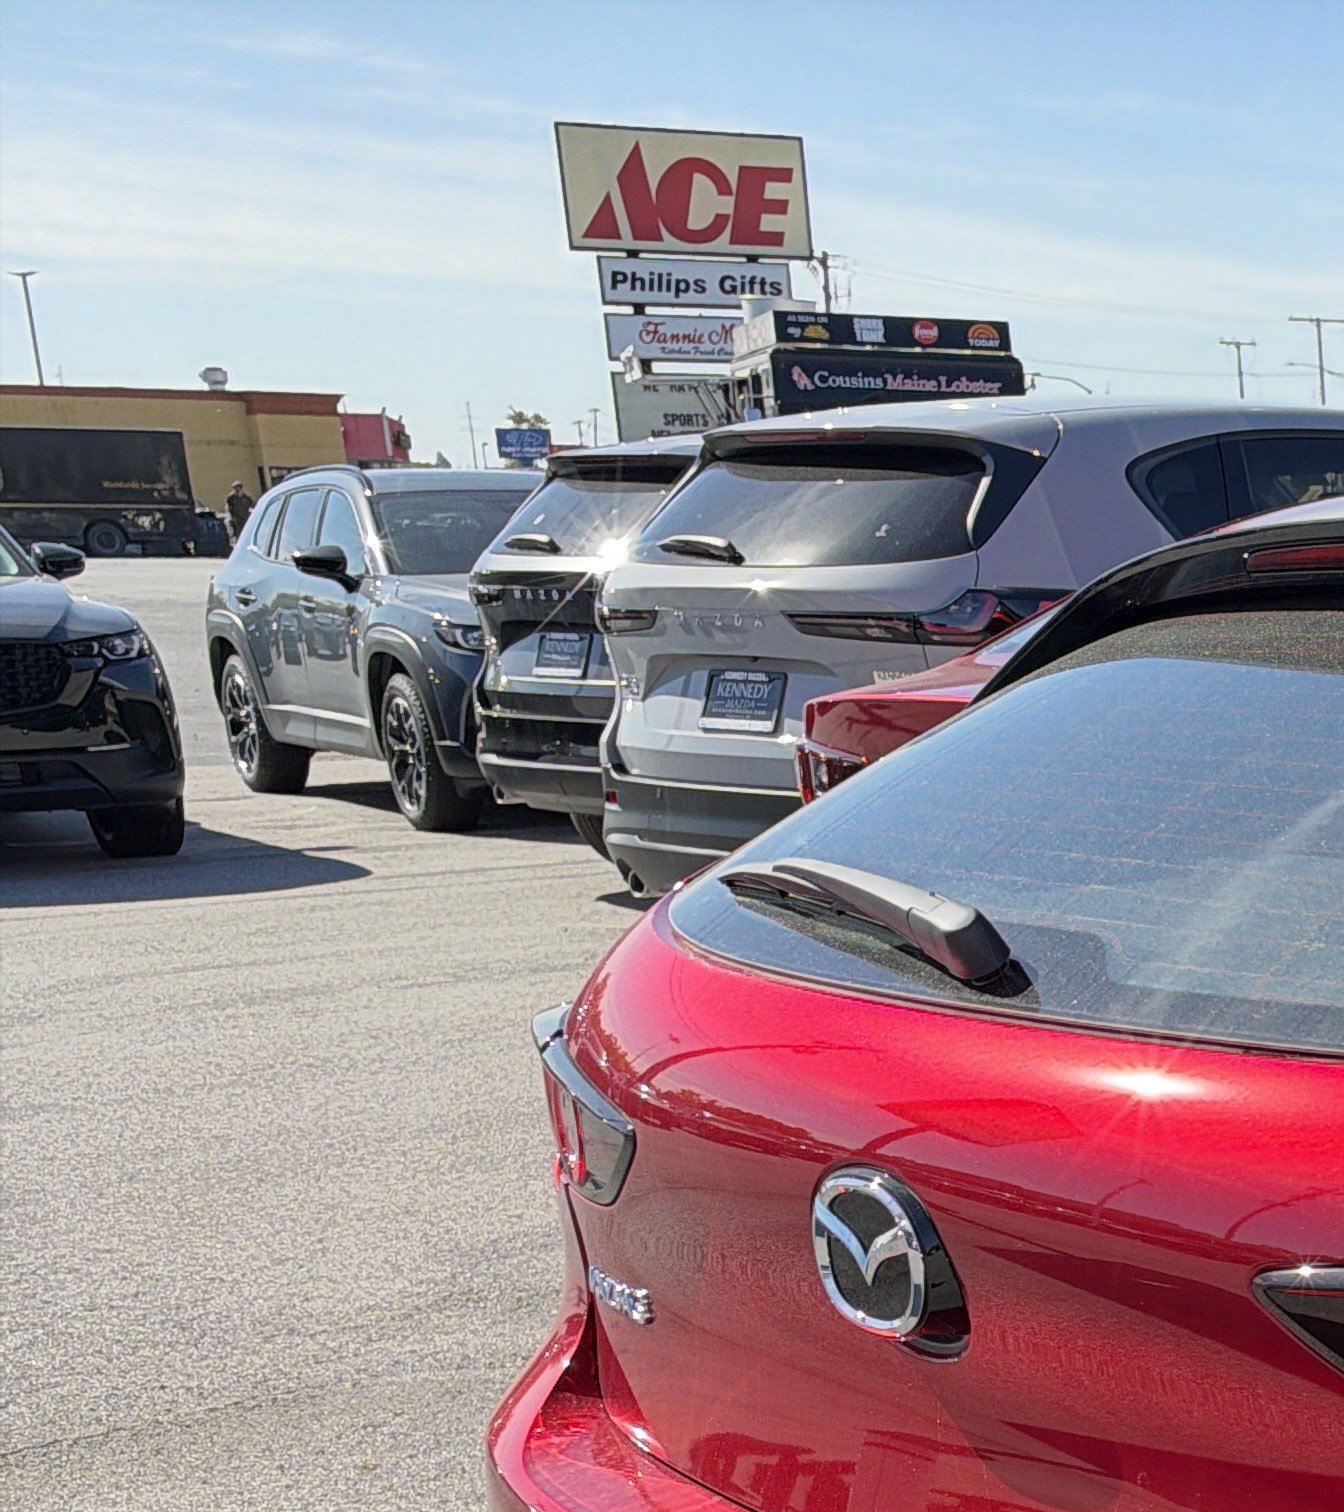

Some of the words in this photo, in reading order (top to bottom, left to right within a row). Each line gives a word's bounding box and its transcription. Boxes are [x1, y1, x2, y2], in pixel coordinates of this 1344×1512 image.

[581, 139, 794, 247] ACE
[610, 270, 707, 299] Philips
[718, 274, 783, 297] Gifts
[638, 320, 705, 345] Fannie
[967, 338, 1000, 348] TODAY
[813, 371, 884, 389] Cousins
[884, 373, 939, 392] Maine
[938, 375, 1002, 393] Lobster
[662, 412, 709, 427] SPORTS
[673, 609, 764, 627] MAZDA
[716, 682, 773, 699] KENNEDY
